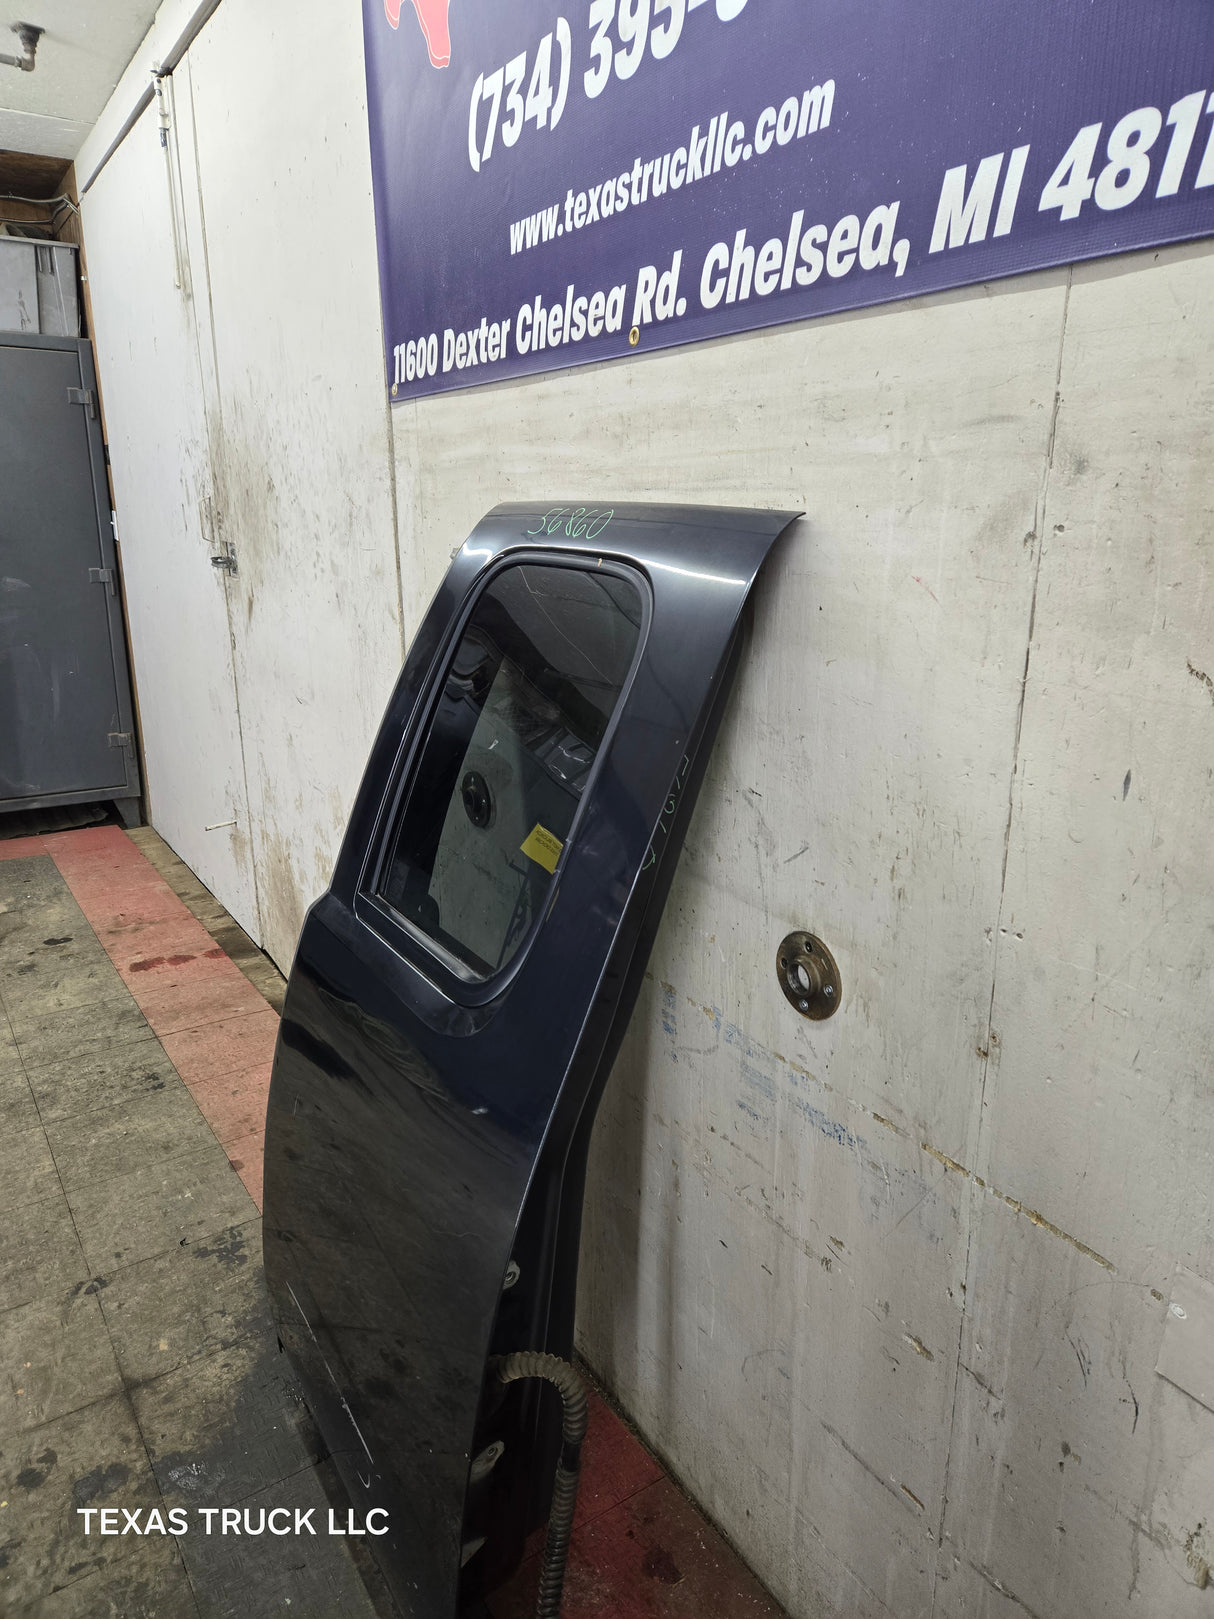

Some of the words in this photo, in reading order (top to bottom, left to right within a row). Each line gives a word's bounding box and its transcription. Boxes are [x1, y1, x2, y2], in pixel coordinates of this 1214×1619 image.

[469, 17, 572, 172] (734)
[583, 0, 749, 99] 395
[510, 79, 836, 256] www.texastruckllc.com
[393, 333, 438, 385] 11600
[443, 318, 511, 373] Dexter
[515, 284, 627, 355] Chelsea
[631, 248, 687, 327] Rd.
[699, 200, 911, 309] Chelsea,
[928, 144, 1031, 255] MI
[527, 507, 614, 539] 56860
